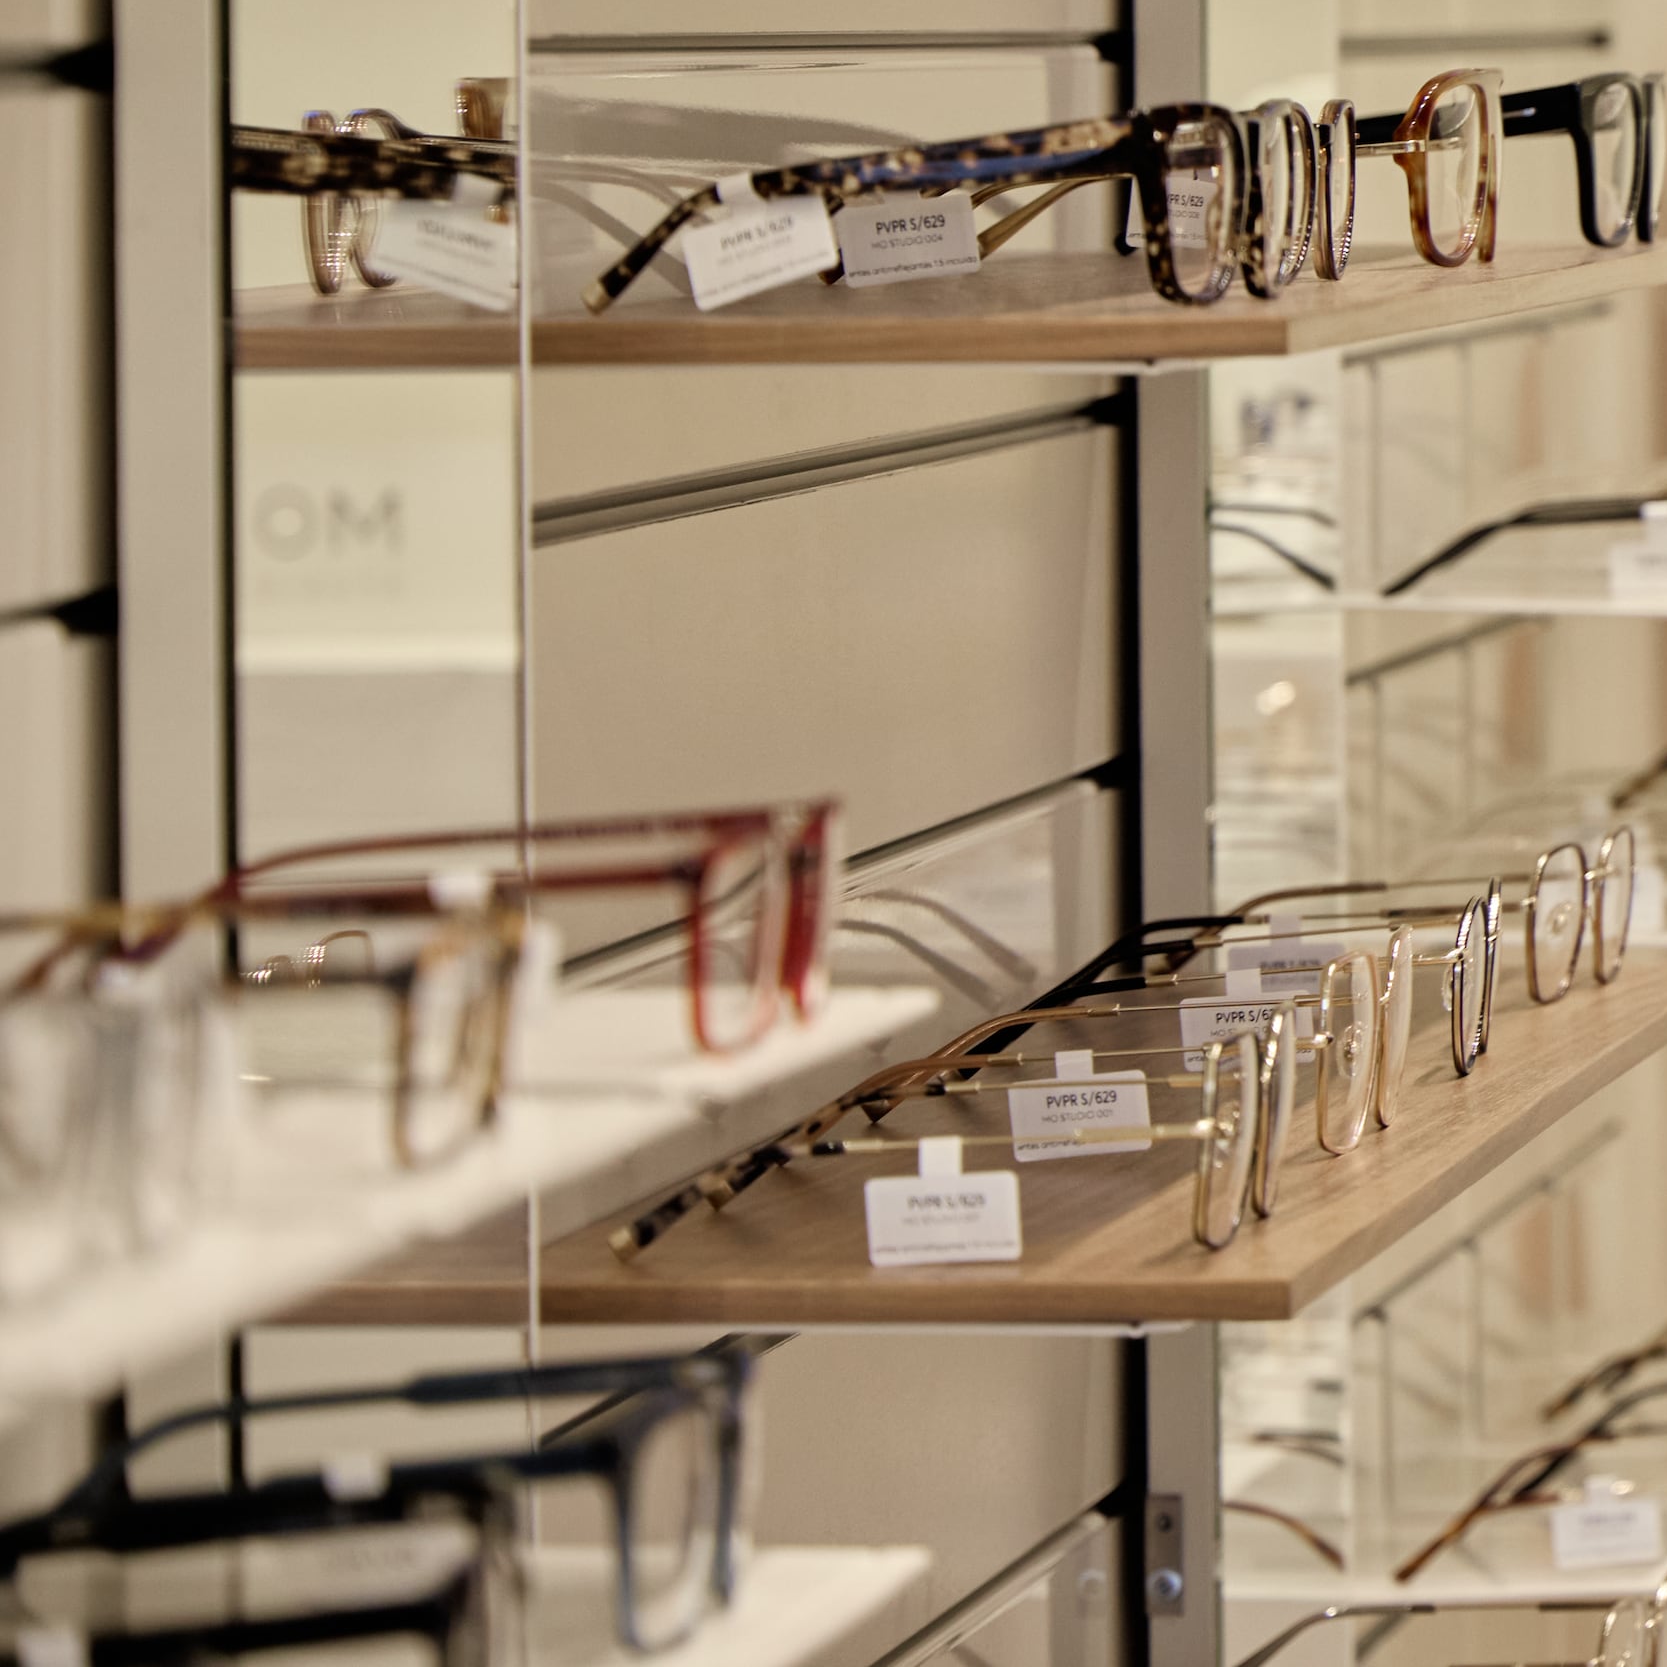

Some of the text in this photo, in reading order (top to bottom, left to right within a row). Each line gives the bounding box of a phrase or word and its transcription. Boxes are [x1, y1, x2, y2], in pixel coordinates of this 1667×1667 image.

[876, 214, 945, 234] PVPR S/629
[1216, 1011, 1245, 1024] PVPR
[1046, 1090, 1117, 1108] PVPR S/629
